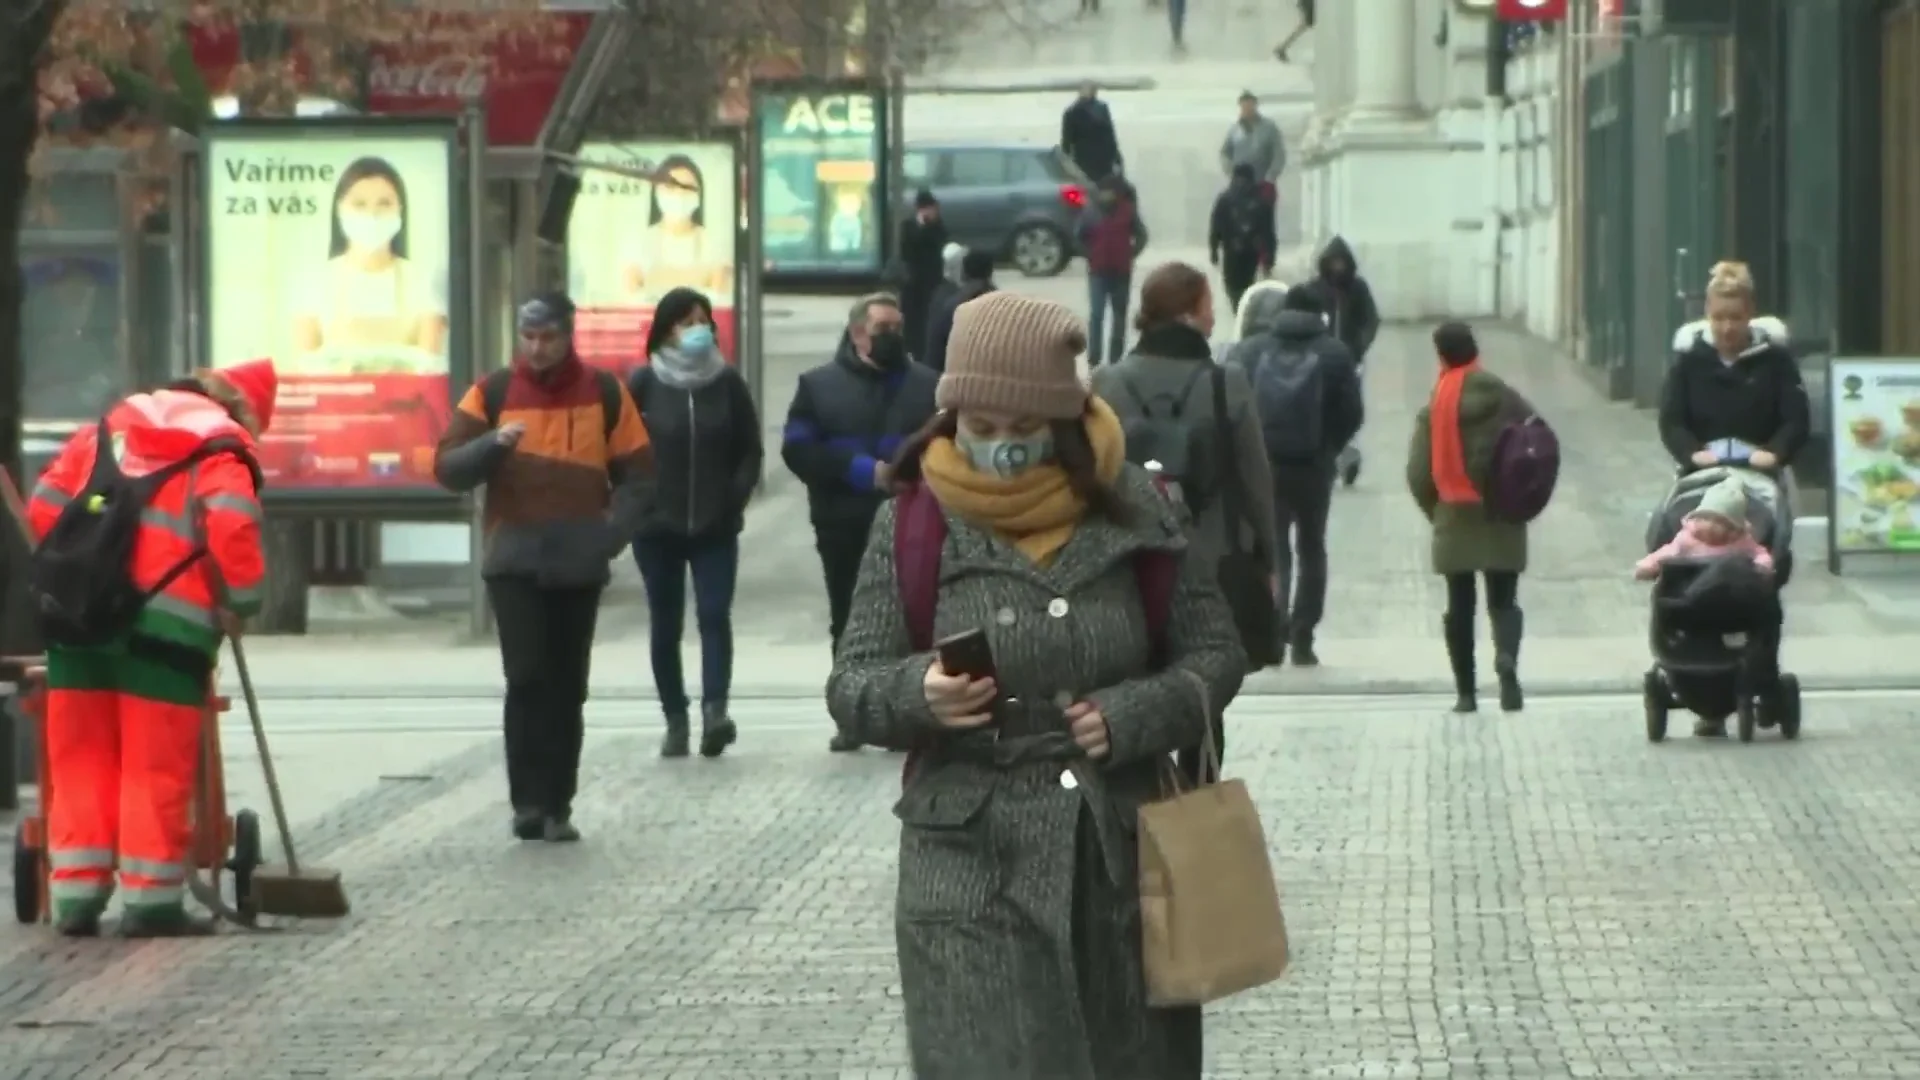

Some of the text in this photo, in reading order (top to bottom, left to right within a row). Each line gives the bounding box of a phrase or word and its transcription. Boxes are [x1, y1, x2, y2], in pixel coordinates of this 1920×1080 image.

[783, 94, 875, 133] ACE
[225, 157, 334, 182] Vaříme
[226, 190, 317, 214] za vás
